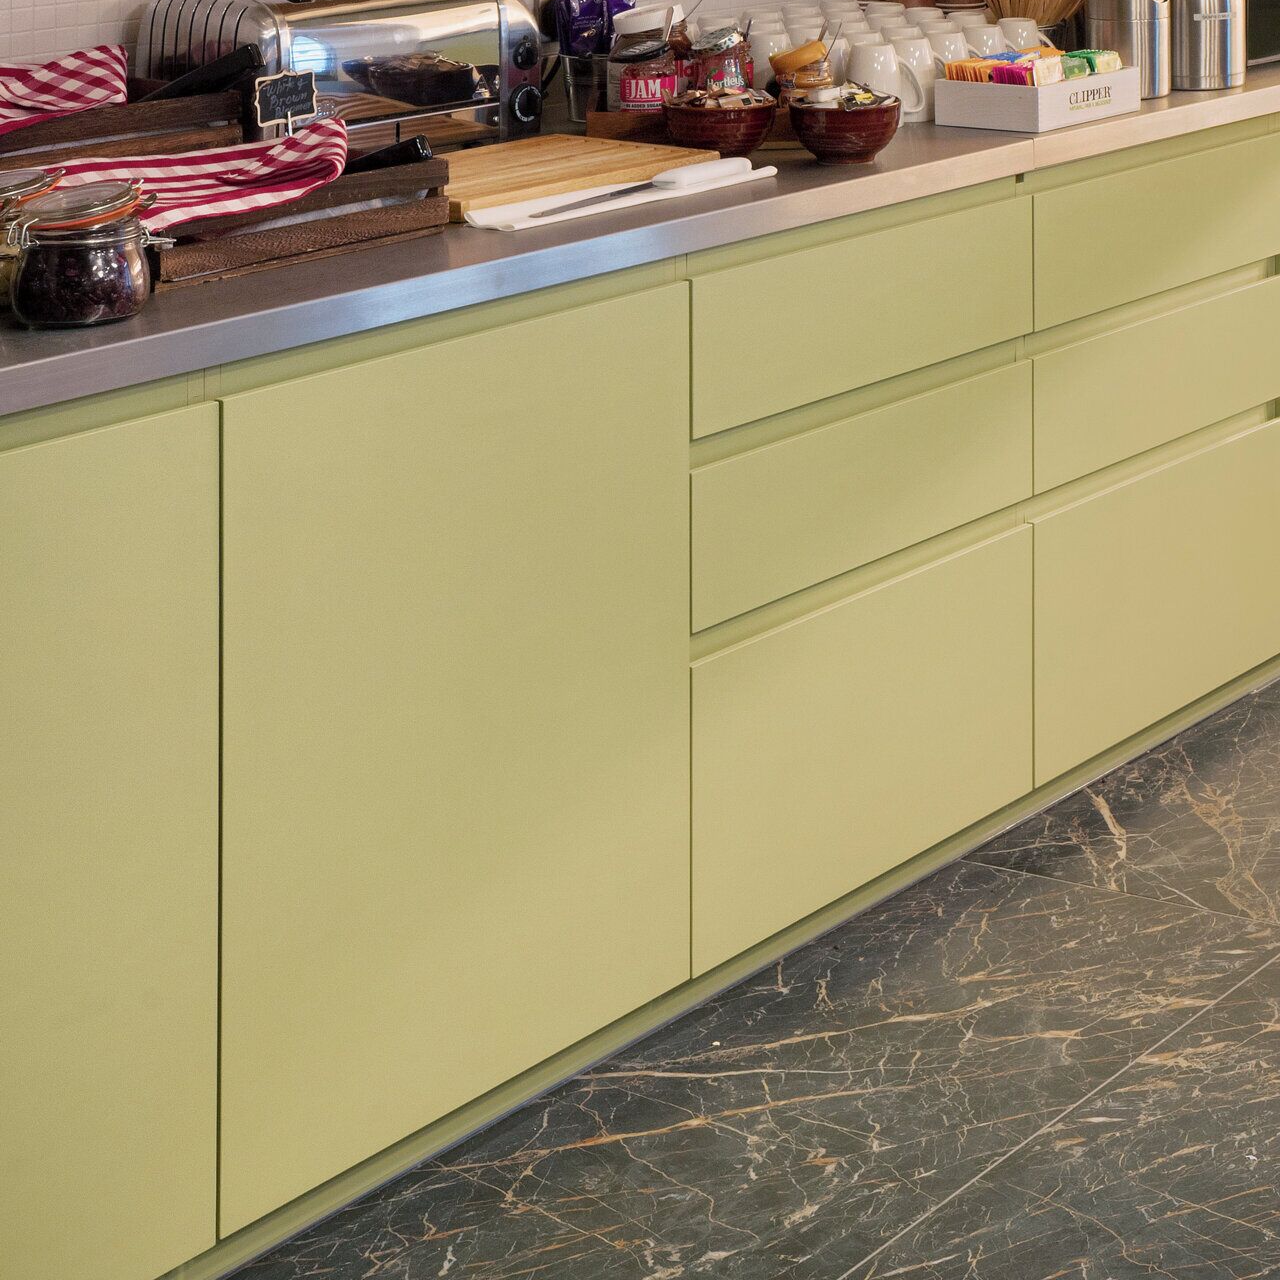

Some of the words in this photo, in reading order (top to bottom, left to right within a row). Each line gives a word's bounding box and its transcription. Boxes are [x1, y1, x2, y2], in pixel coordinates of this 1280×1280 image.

[630, 79, 662, 99] JAM
[1069, 86, 1111, 105] CLIPPER
[270, 92, 308, 108] Brown
